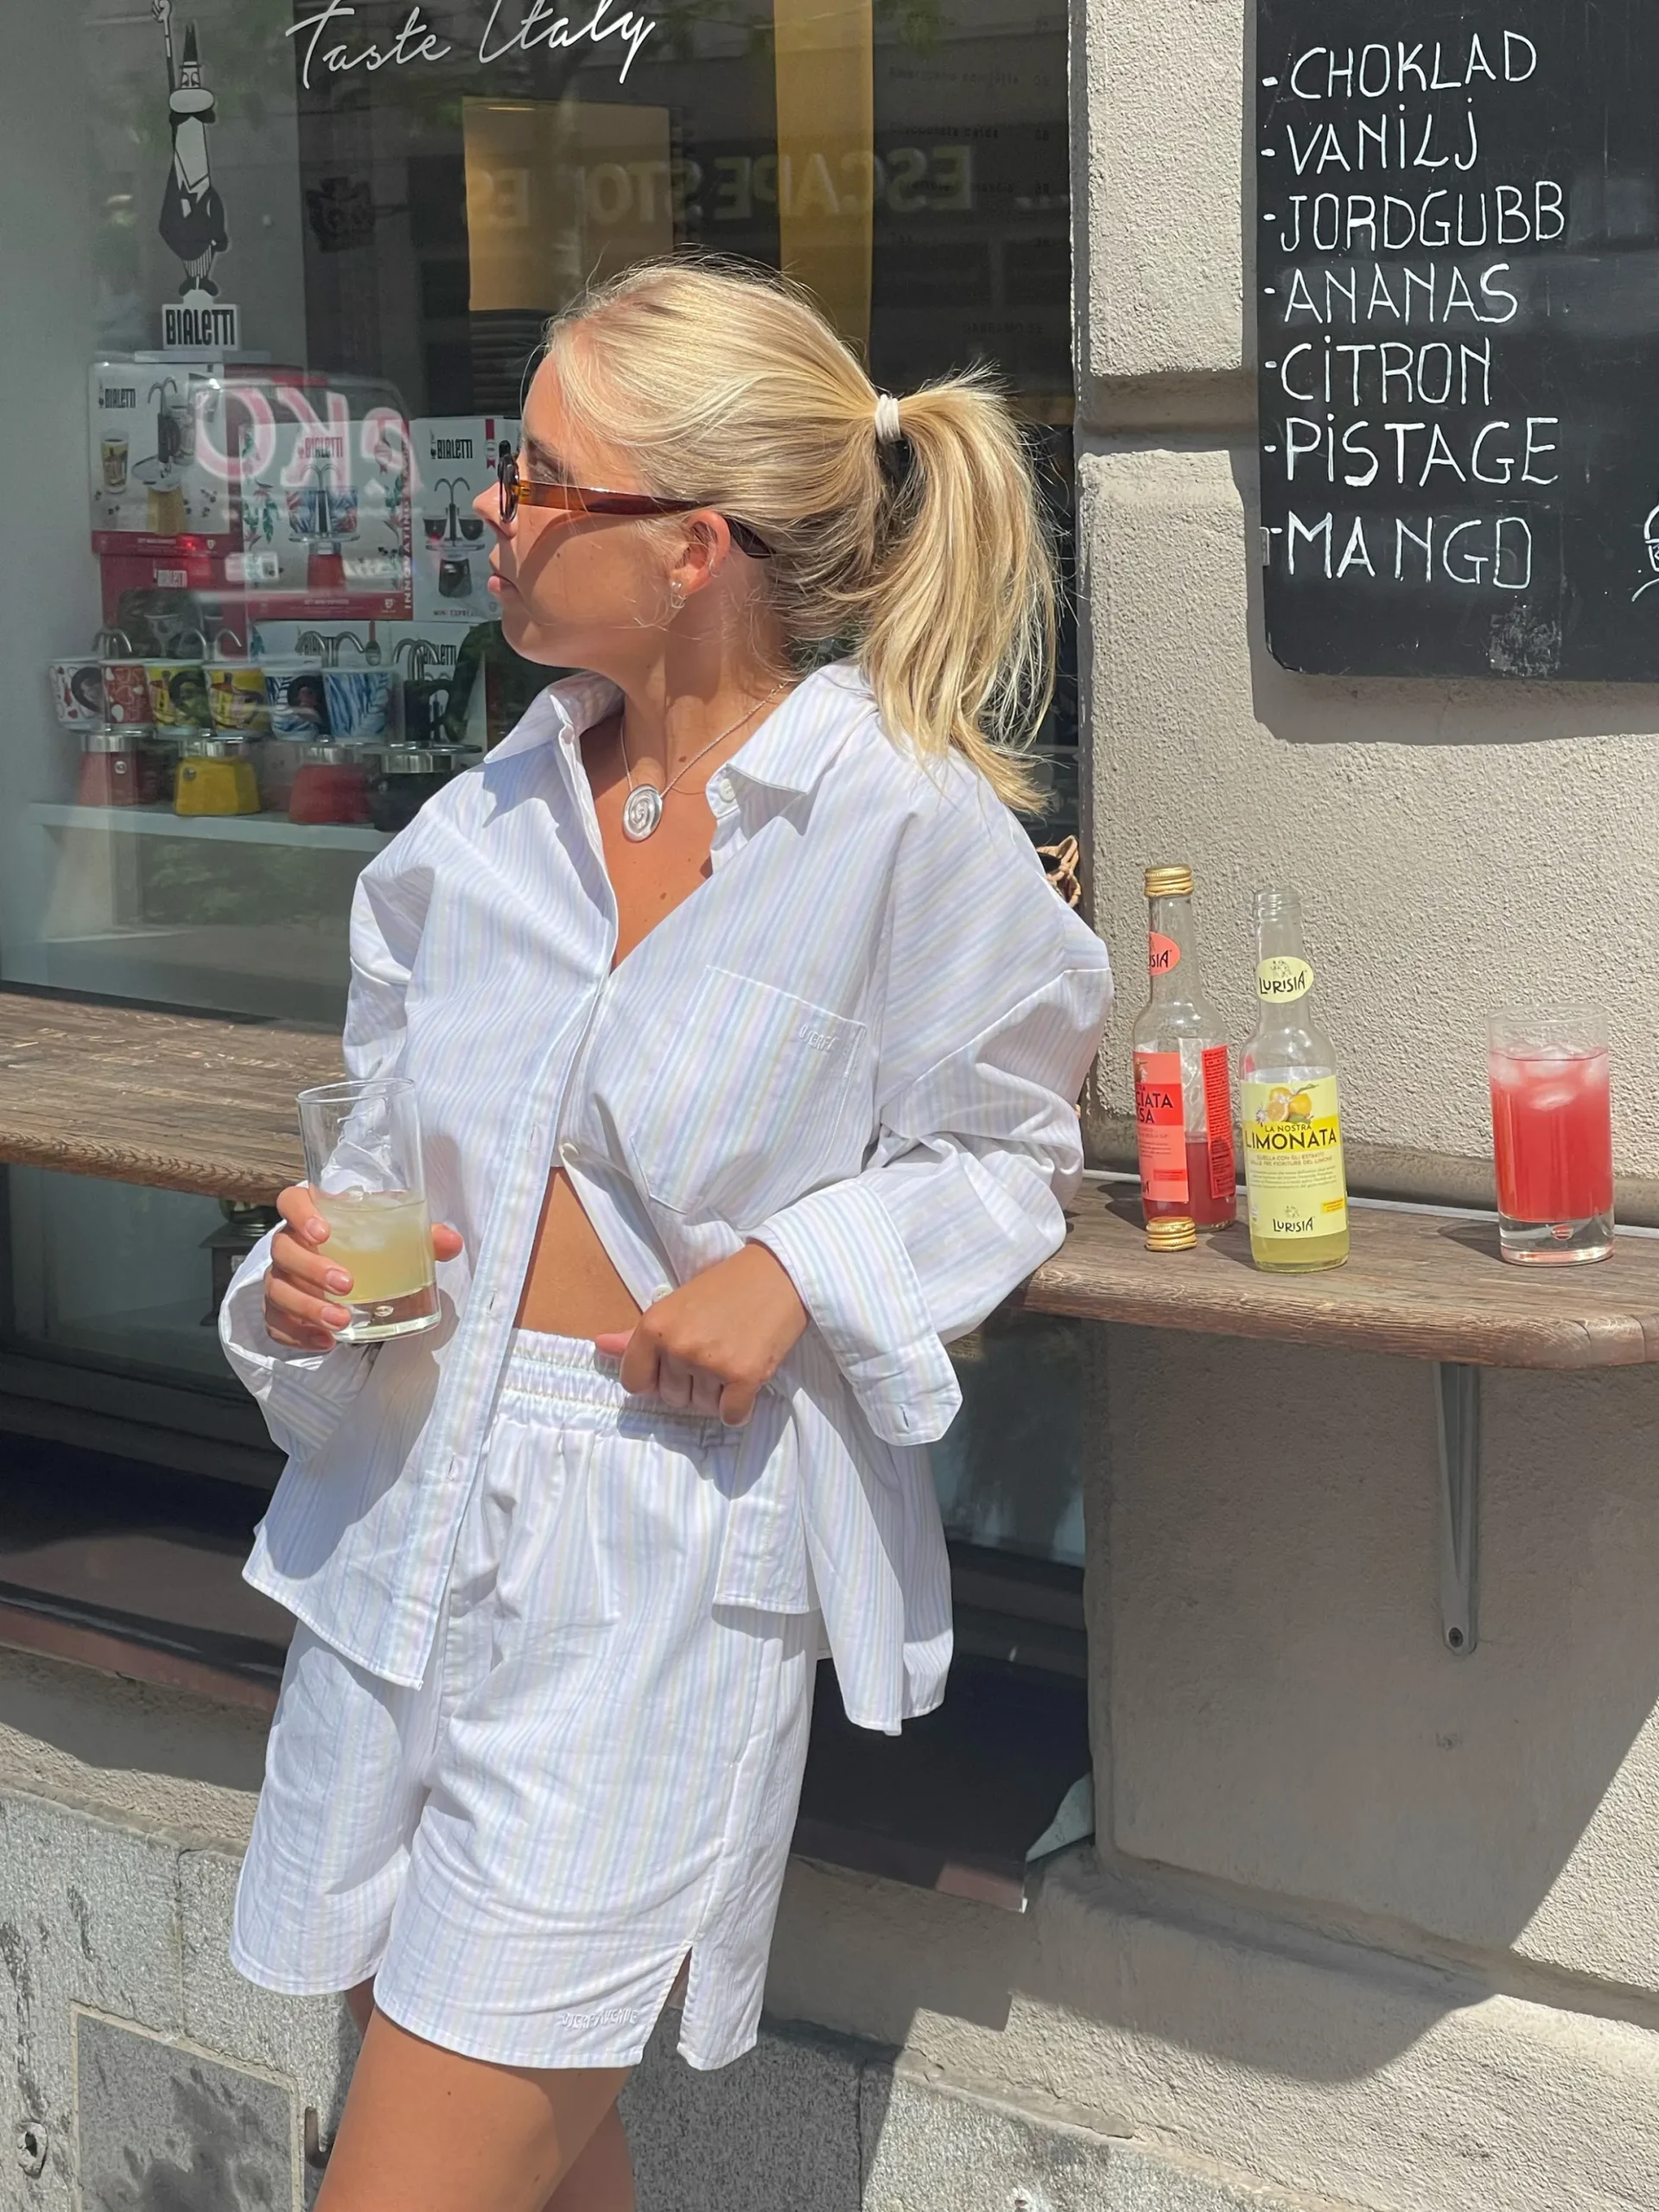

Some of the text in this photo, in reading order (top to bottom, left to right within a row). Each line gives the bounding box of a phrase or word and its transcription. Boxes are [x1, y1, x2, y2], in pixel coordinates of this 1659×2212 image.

[286, 0, 656, 89] Taste Italy
[1291, 31, 1537, 100] CHOKLAD
[1281, 181, 1565, 252] JORDGUBB
[1284, 264, 1518, 324] ANANAS
[165, 308, 237, 346] BIALETTI
[105, 388, 136, 409] BIALETTI
[305, 437, 343, 458] BIALETTI
[437, 439, 473, 460] BIALETTI
[1258, 970, 1306, 995] LURISIA
[1137, 1108, 1155, 1124] SA
[1277, 1123, 1312, 1132] NOSTRA
[1244, 1128, 1337, 1151] LIMONATA
[1273, 1217, 1314, 1233] LURISIA
